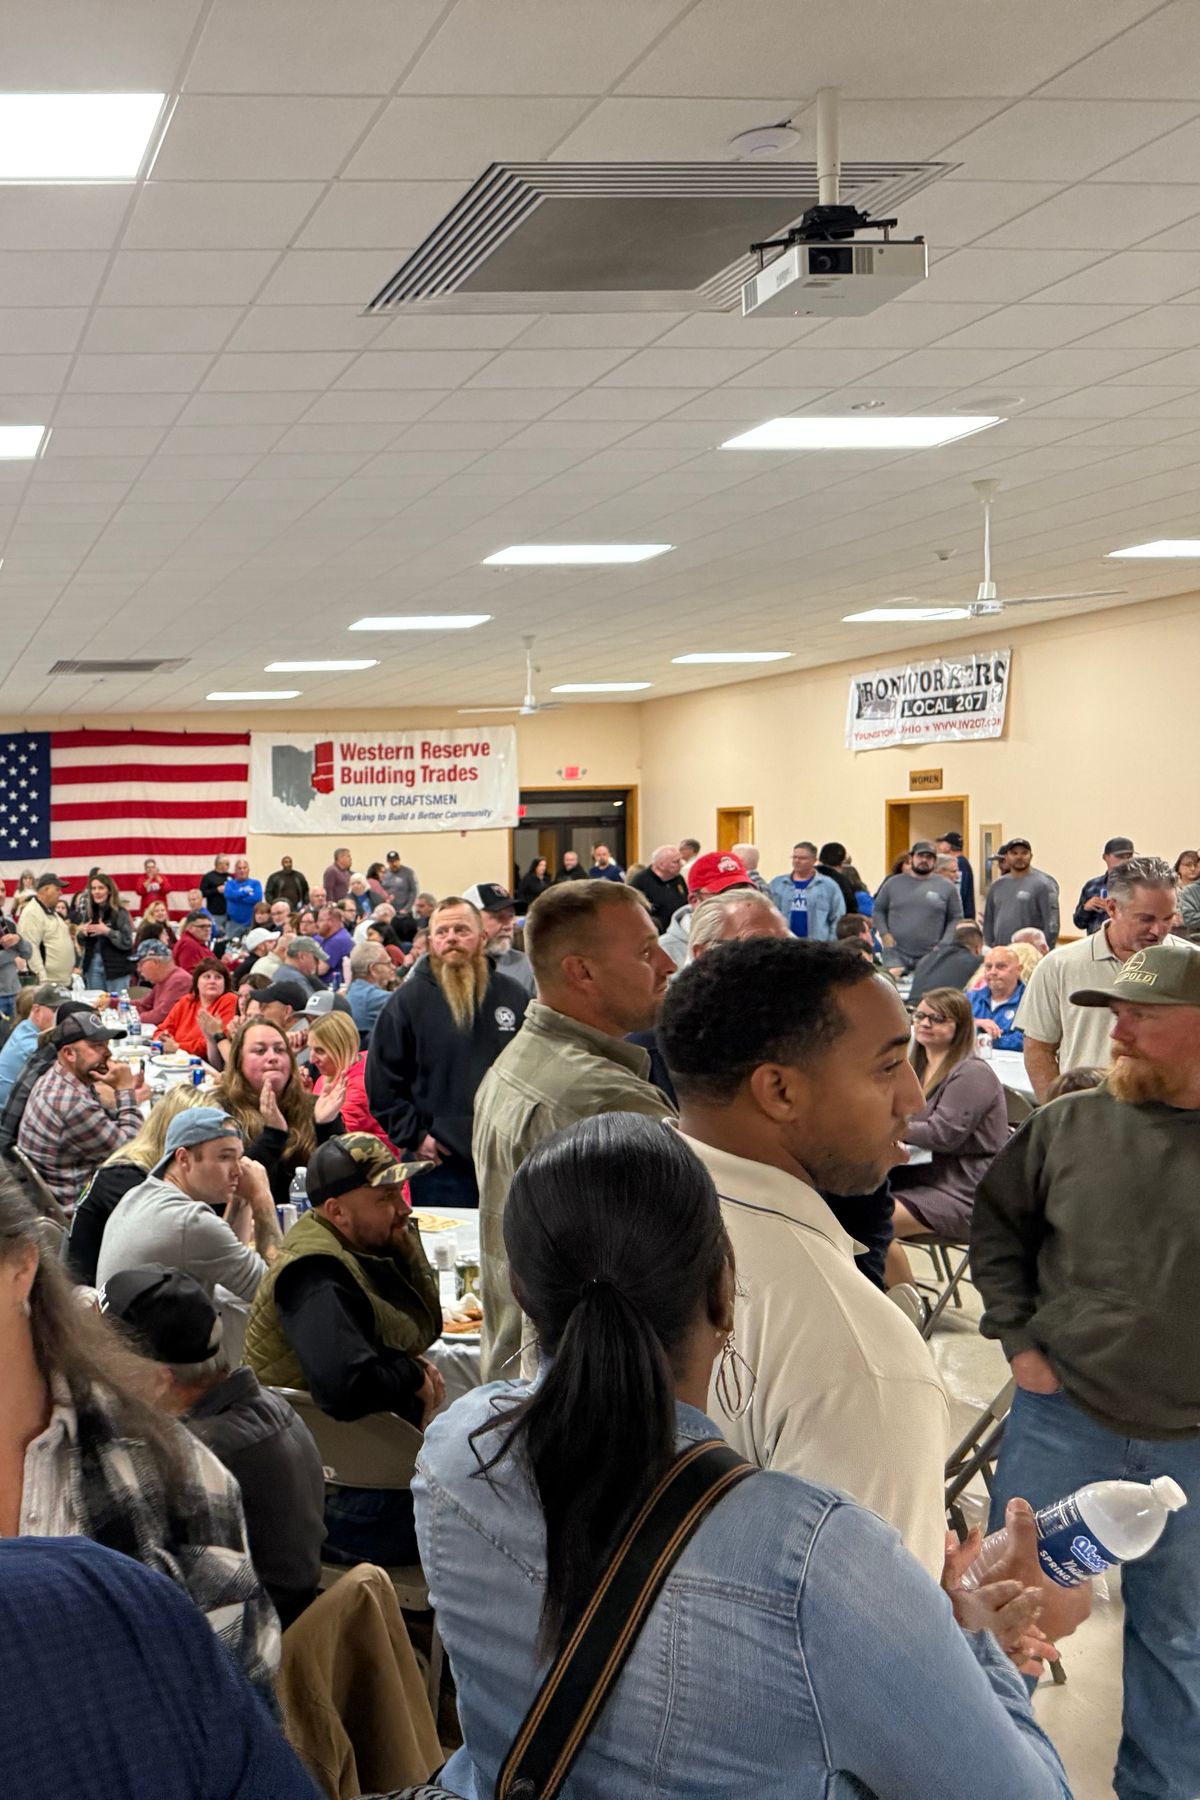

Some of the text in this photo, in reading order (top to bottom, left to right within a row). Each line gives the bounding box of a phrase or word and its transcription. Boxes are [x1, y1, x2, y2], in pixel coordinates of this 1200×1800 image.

[904, 694, 984, 717] LOCAL 207
[340, 741, 491, 761] Western Reserve
[340, 765, 479, 787] Building Trades
[911, 776, 939, 784] WOMEN
[340, 794, 458, 807] QUALITY CRAFTSMEN
[341, 813, 375, 823] Working
[377, 813, 386, 821] to
[388, 812, 409, 821] Build
[418, 811, 443, 821] Better
[445, 808, 493, 819] Community
[1039, 1549, 1071, 1582] SPRING
